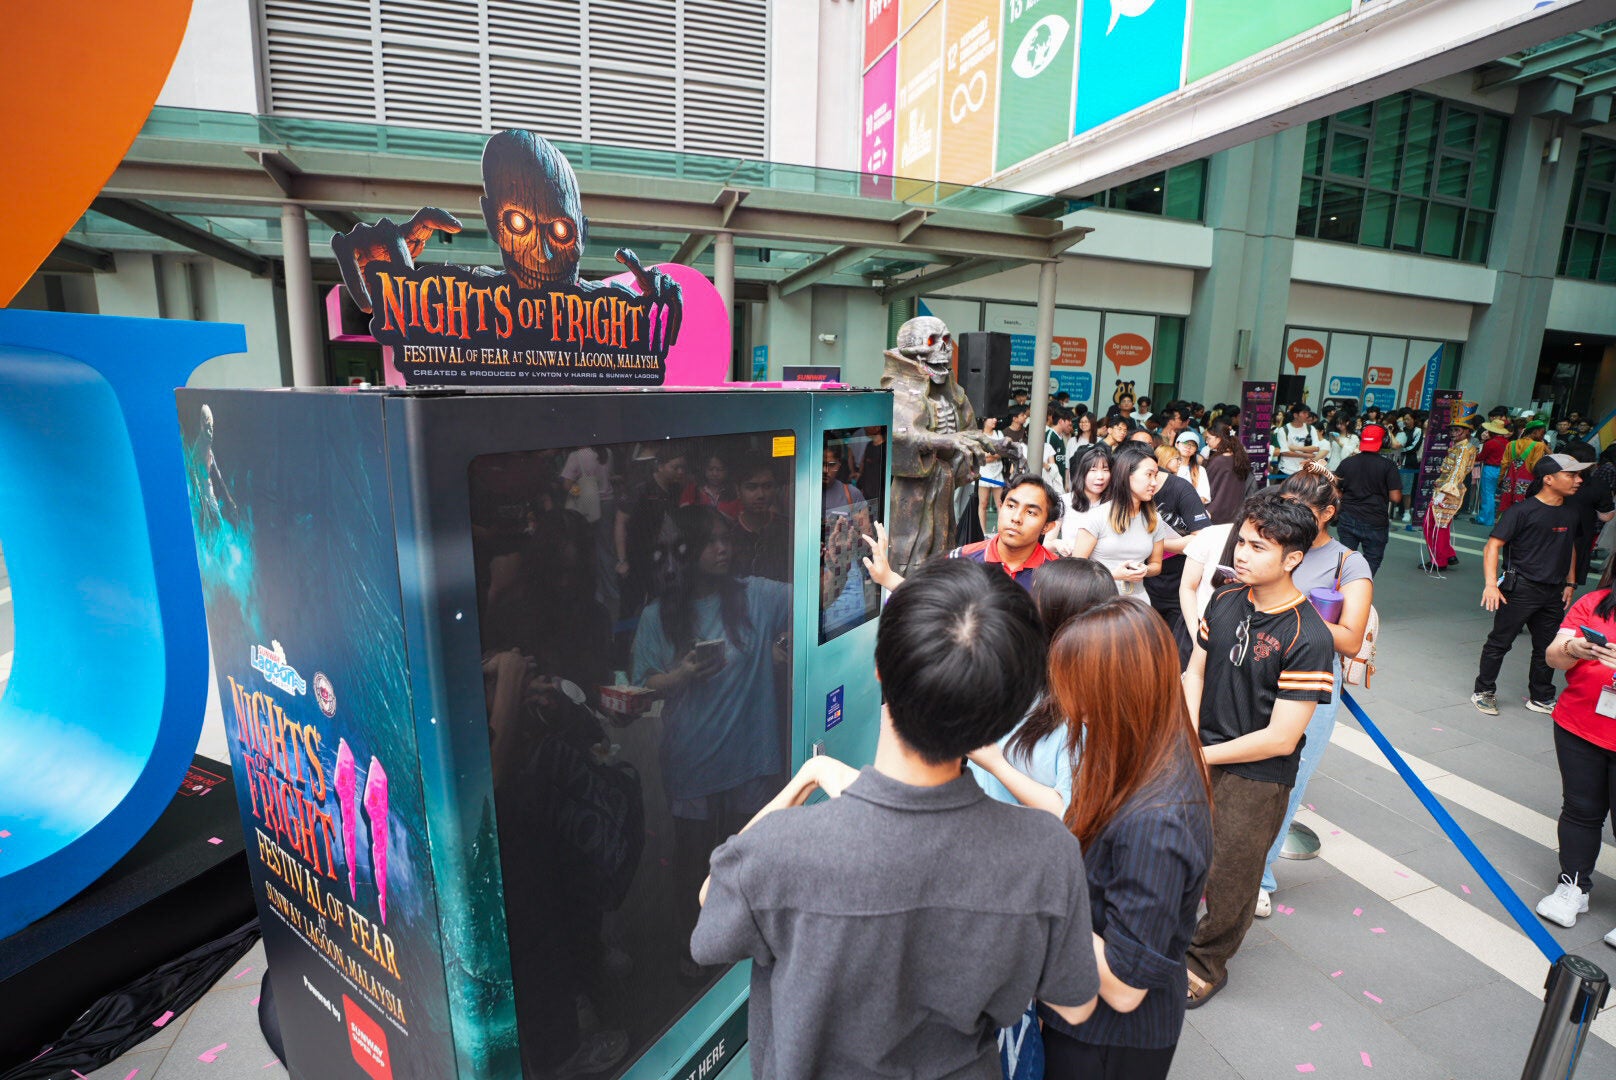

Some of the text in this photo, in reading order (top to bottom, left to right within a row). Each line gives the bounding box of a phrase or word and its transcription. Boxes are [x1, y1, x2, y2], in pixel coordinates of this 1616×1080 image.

[376, 272, 513, 340] NIGHTS
[517, 298, 546, 329] OF
[548, 292, 644, 352] FRIGHT
[403, 345, 659, 370] FESTIVAL OF FEAR AT SUNWAY LAGOON, MALAYSIA
[1428, 356, 1439, 385] YOUR
[252, 646, 296, 688] Lagoon
[228, 675, 327, 801] NIGHTS
[255, 753, 269, 773] OF
[243, 752, 339, 881] FRIGHT
[255, 827, 401, 981] FESTIVAL OF FEAR
[317, 913, 327, 934] AT
[265, 880, 406, 1025] SUNWAY LAGOON, MALAYSIA
[303, 975, 340, 1022] Powered by
[351, 1022, 383, 1058] SUNWAY
[698, 1038, 726, 1080] HERE
